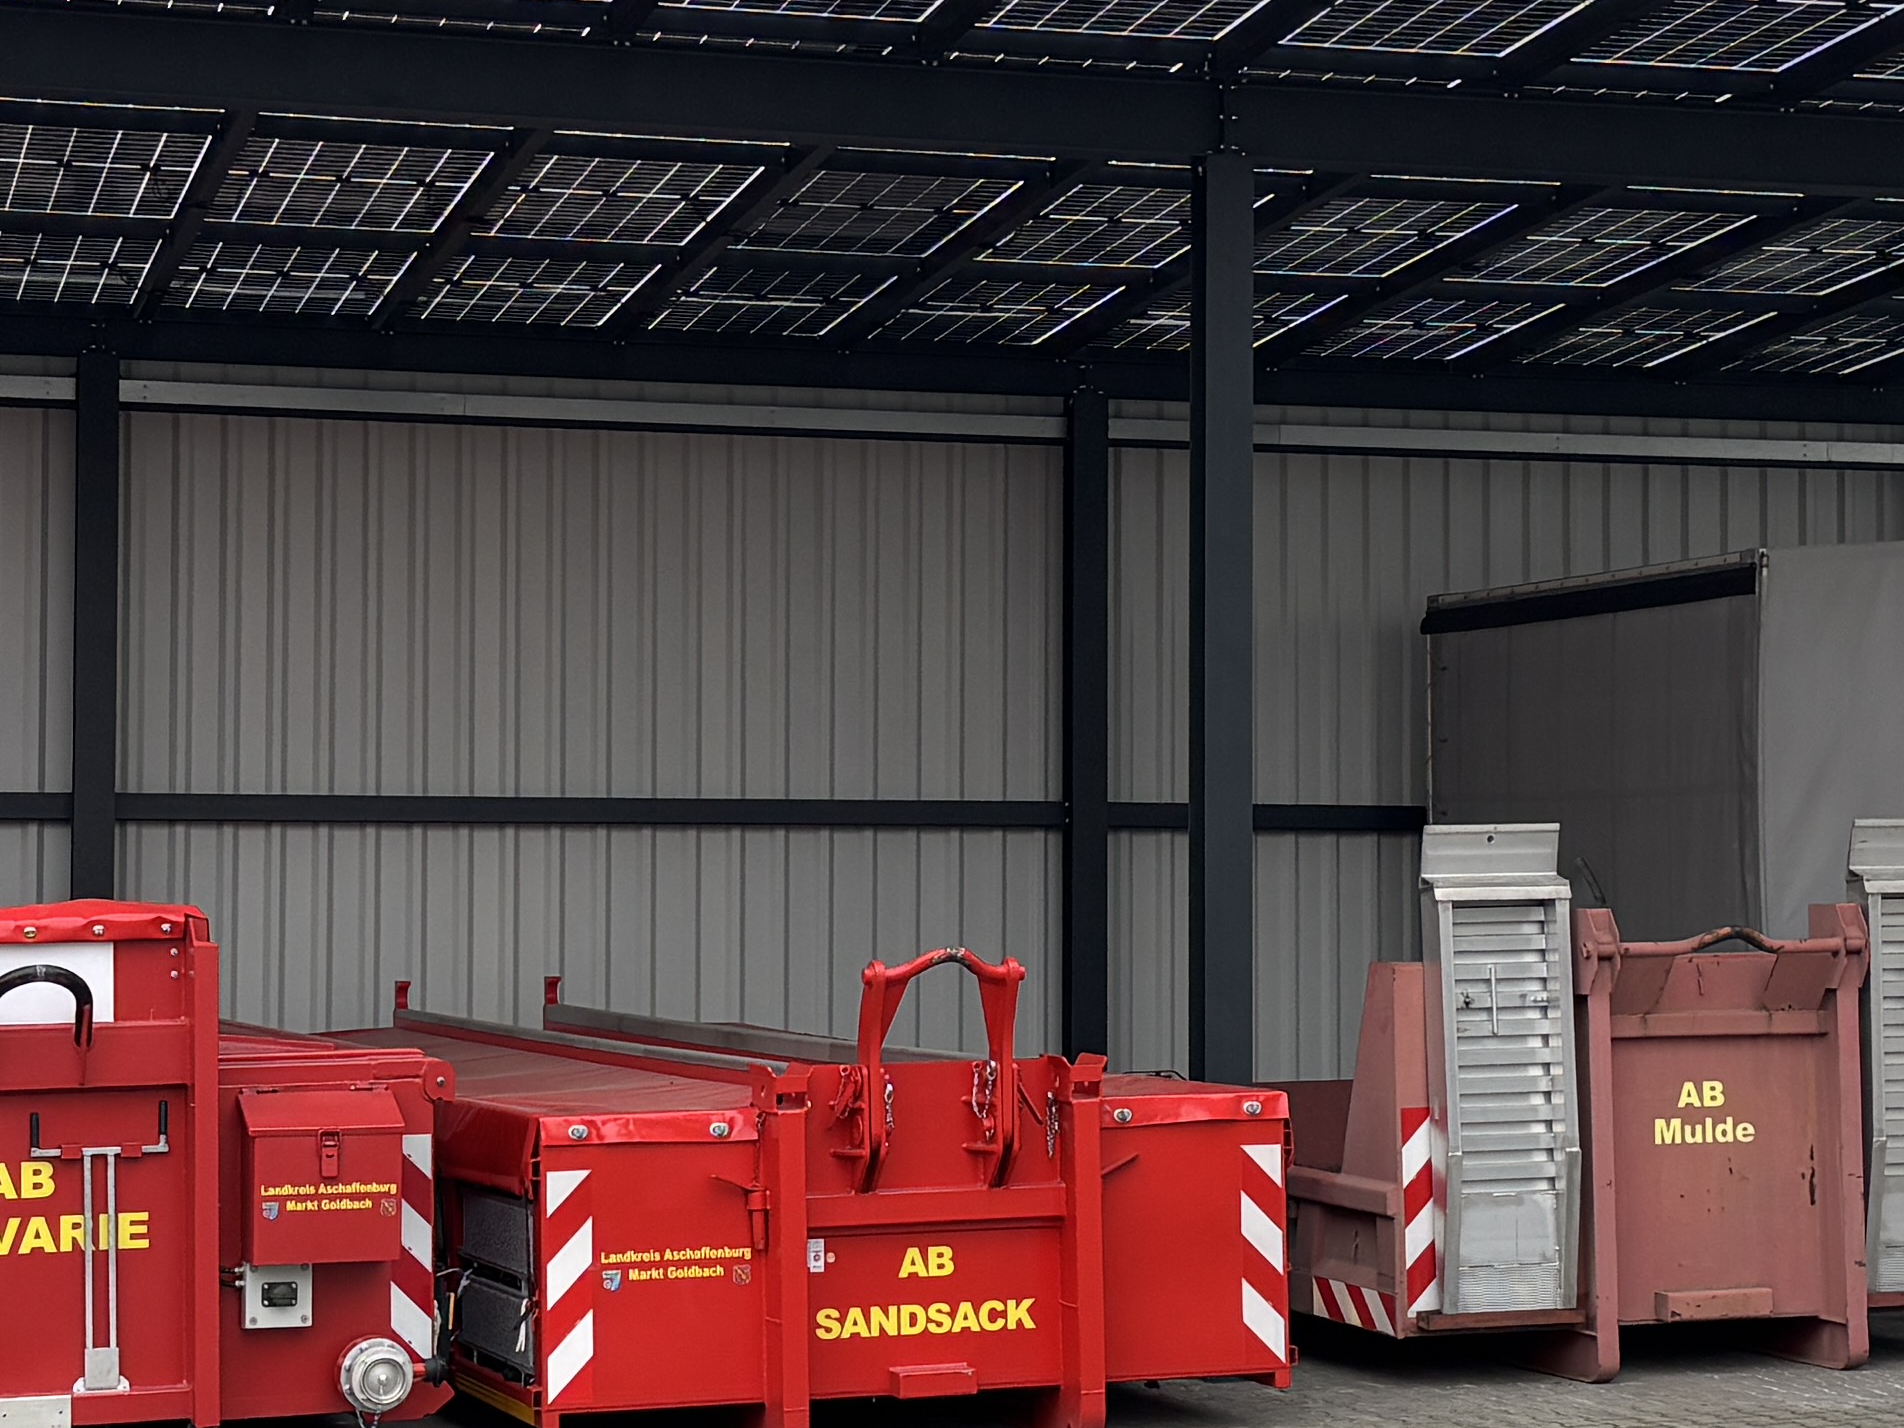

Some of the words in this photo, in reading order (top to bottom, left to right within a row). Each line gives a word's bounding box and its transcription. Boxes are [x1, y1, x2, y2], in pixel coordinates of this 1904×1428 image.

[1677, 1080, 1726, 1109] AB
[1654, 1116, 1756, 1145] Mulde
[260, 1183, 317, 1196] Landkreis
[317, 1181, 397, 1195] Aschaffenburg
[285, 1199, 319, 1212] Markt
[321, 1197, 373, 1211] Goldbach
[600, 1248, 661, 1264] Landkreis
[663, 1245, 752, 1261] Aschaffenburg
[897, 1244, 956, 1279] AB
[628, 1266, 664, 1281] Markt
[667, 1264, 725, 1279] Goldbach
[815, 1297, 1037, 1341] SANDSACK
